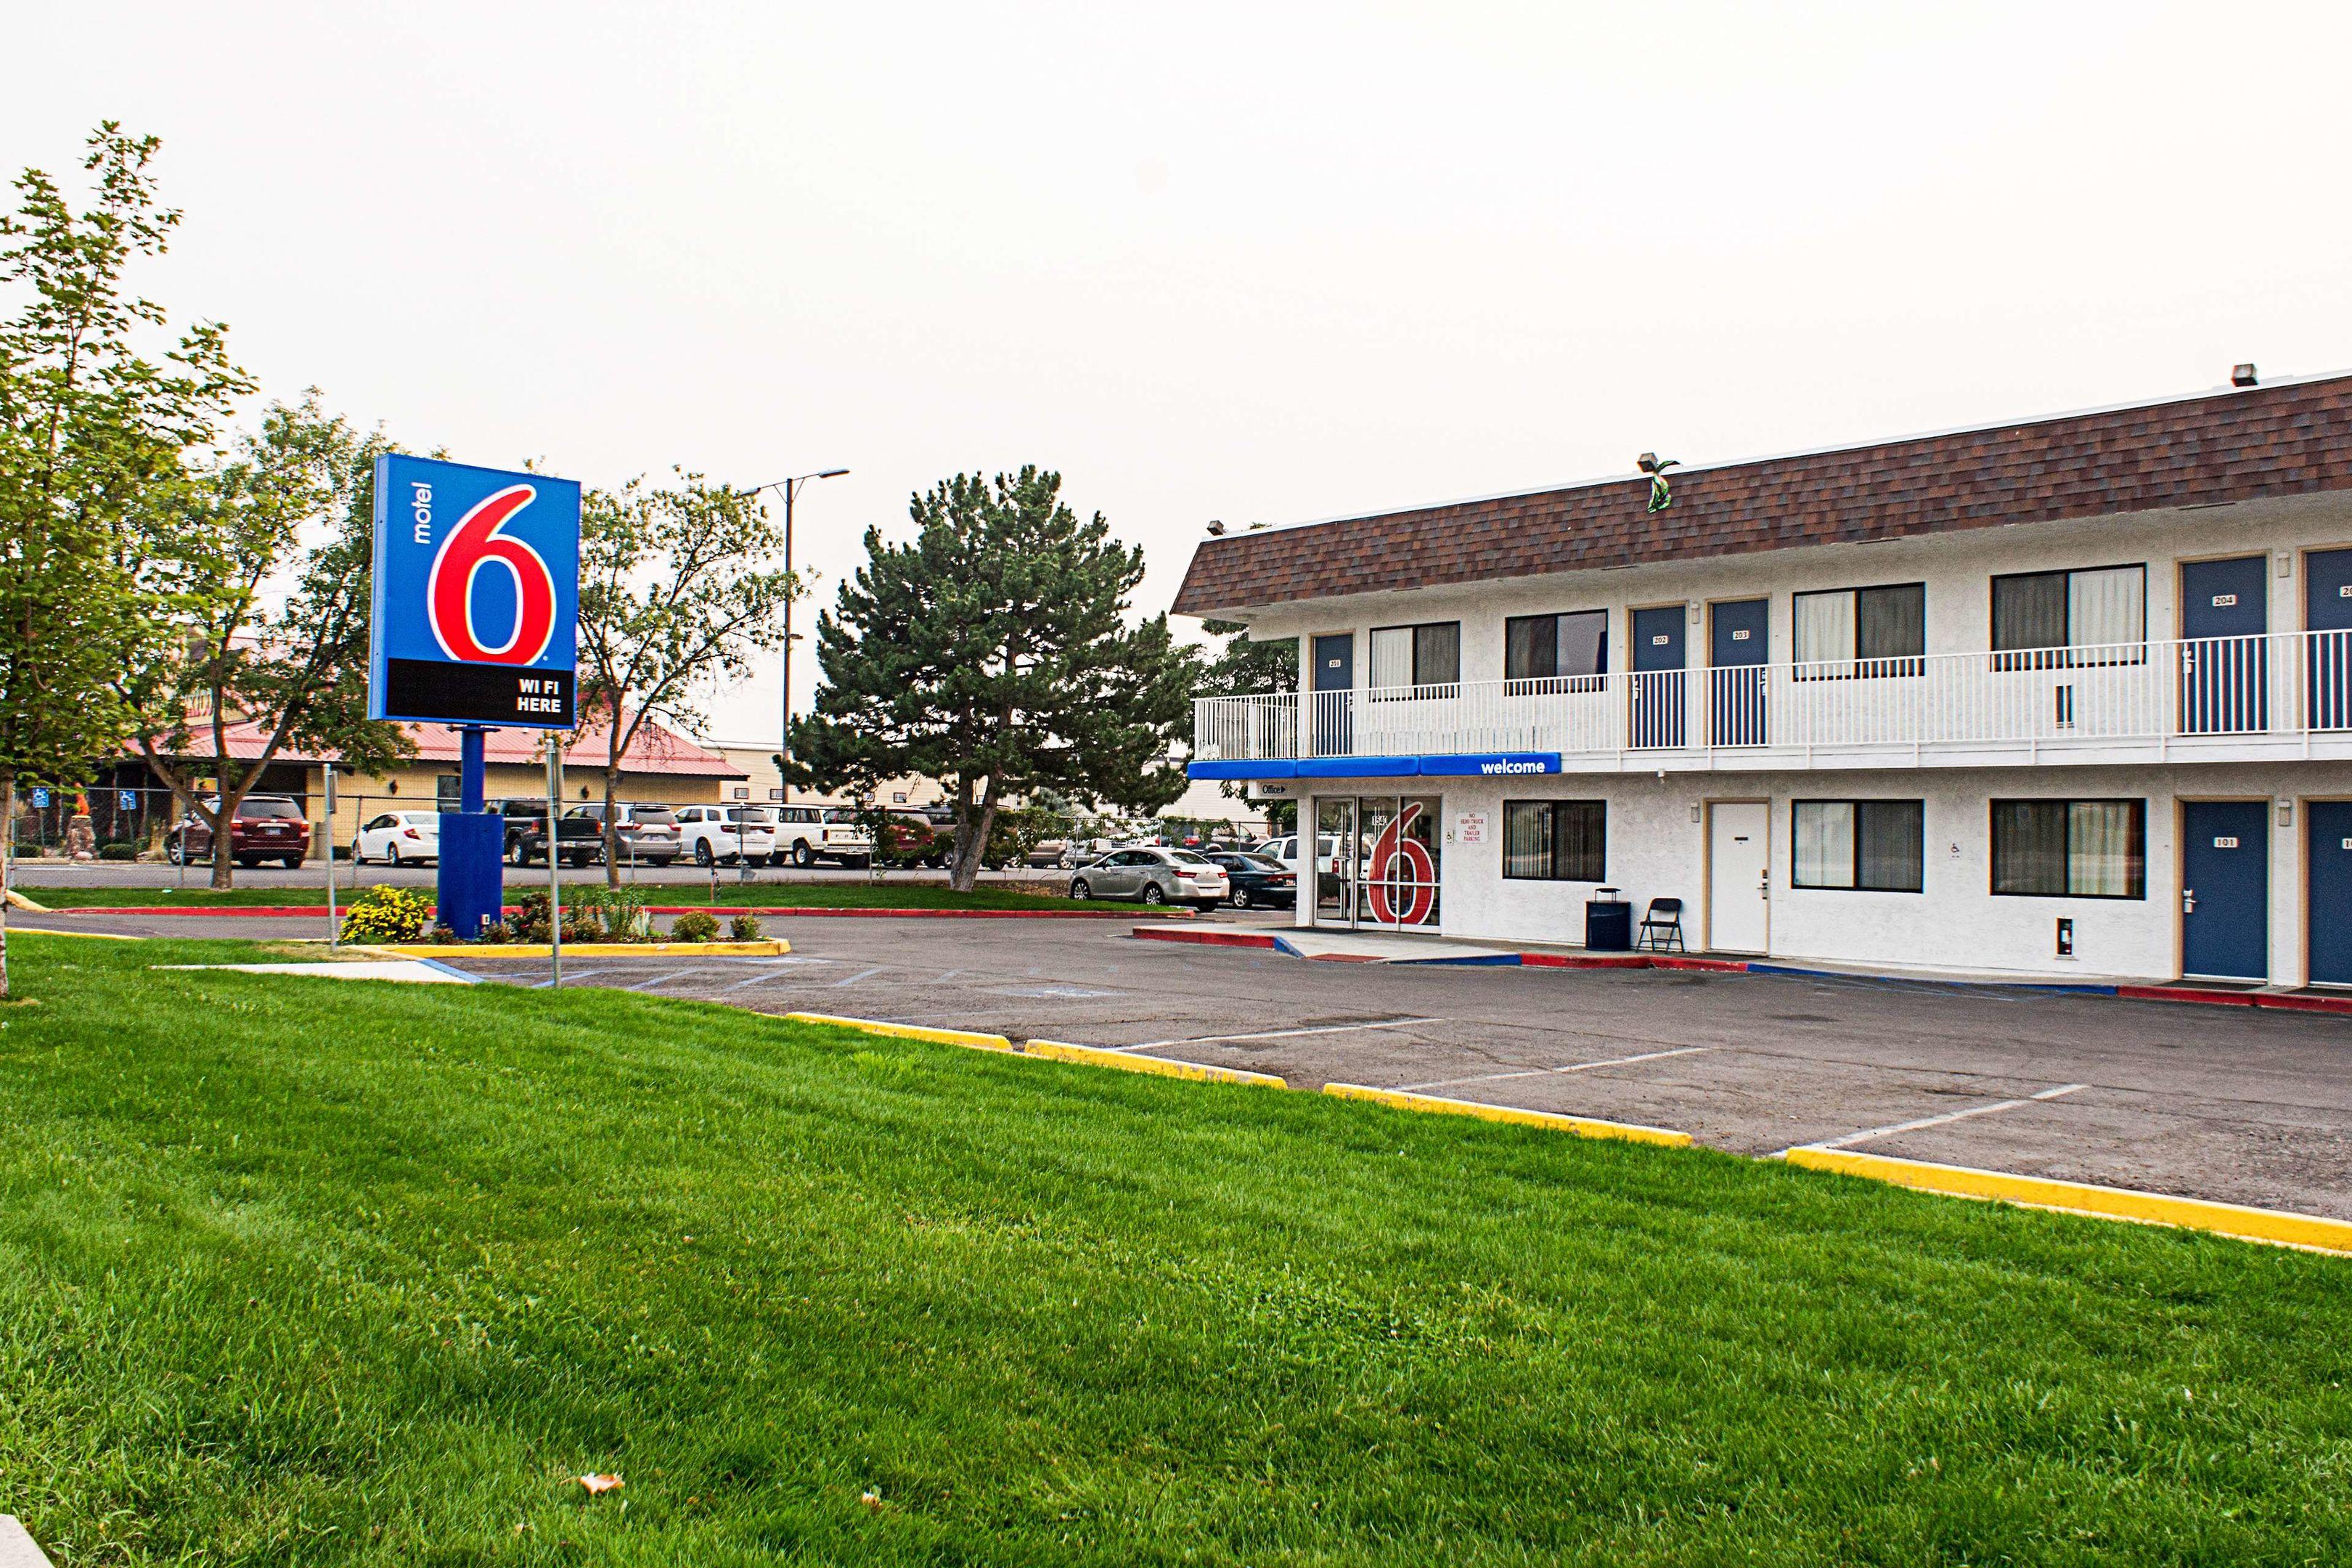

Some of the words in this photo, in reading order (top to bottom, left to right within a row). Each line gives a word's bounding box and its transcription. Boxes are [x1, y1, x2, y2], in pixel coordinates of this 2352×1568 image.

[411, 482, 432, 544] motel
[427, 483, 557, 666] 6
[2215, 596, 2233, 605] 204
[519, 678, 540, 693] WI
[544, 680, 559, 695] FI
[517, 696, 562, 714] HERE
[1481, 758, 1545, 775] welcome
[1262, 785, 1282, 794] Office
